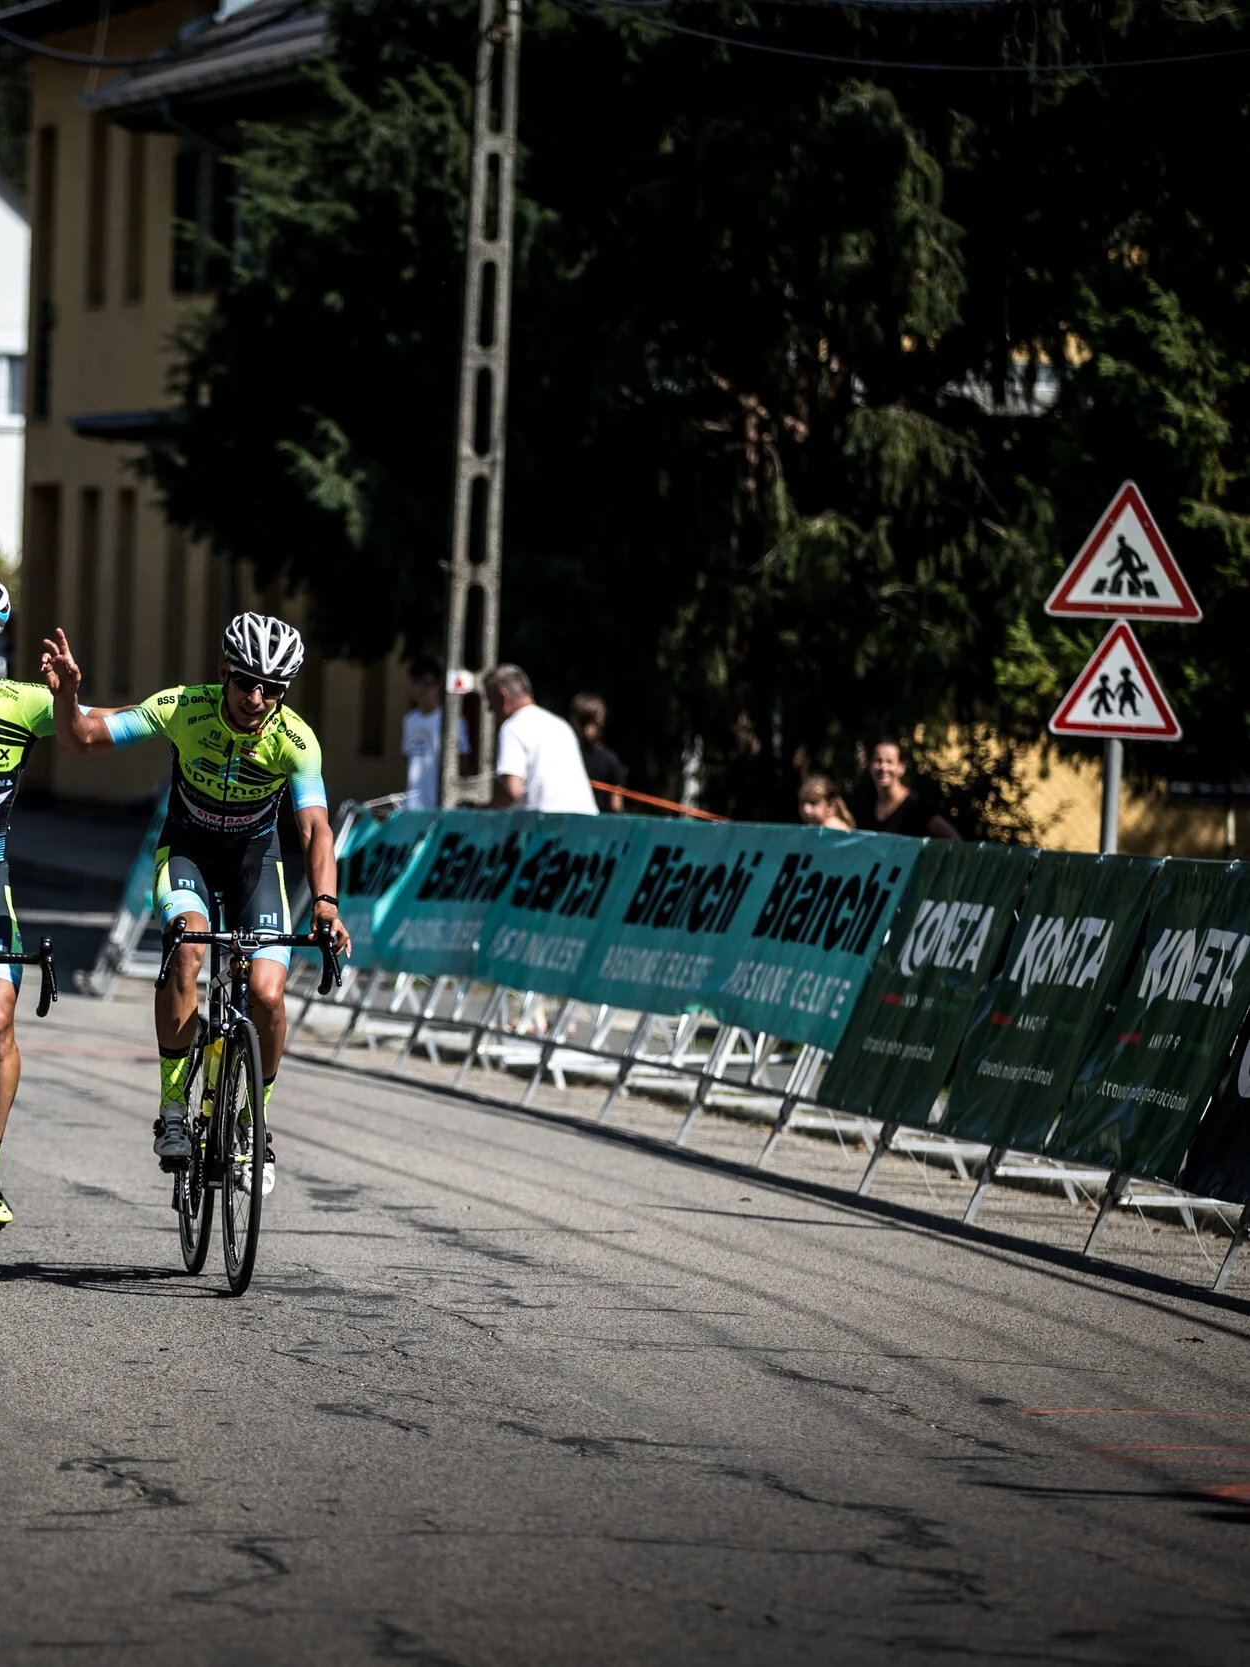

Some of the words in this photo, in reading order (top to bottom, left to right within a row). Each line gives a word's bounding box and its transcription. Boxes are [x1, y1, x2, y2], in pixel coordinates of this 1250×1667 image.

[157, 695, 175, 706] BSS
[196, 809, 254, 824] STRABAG
[623, 843, 764, 935] Bianchi
[752, 853, 902, 955] Bianchi
